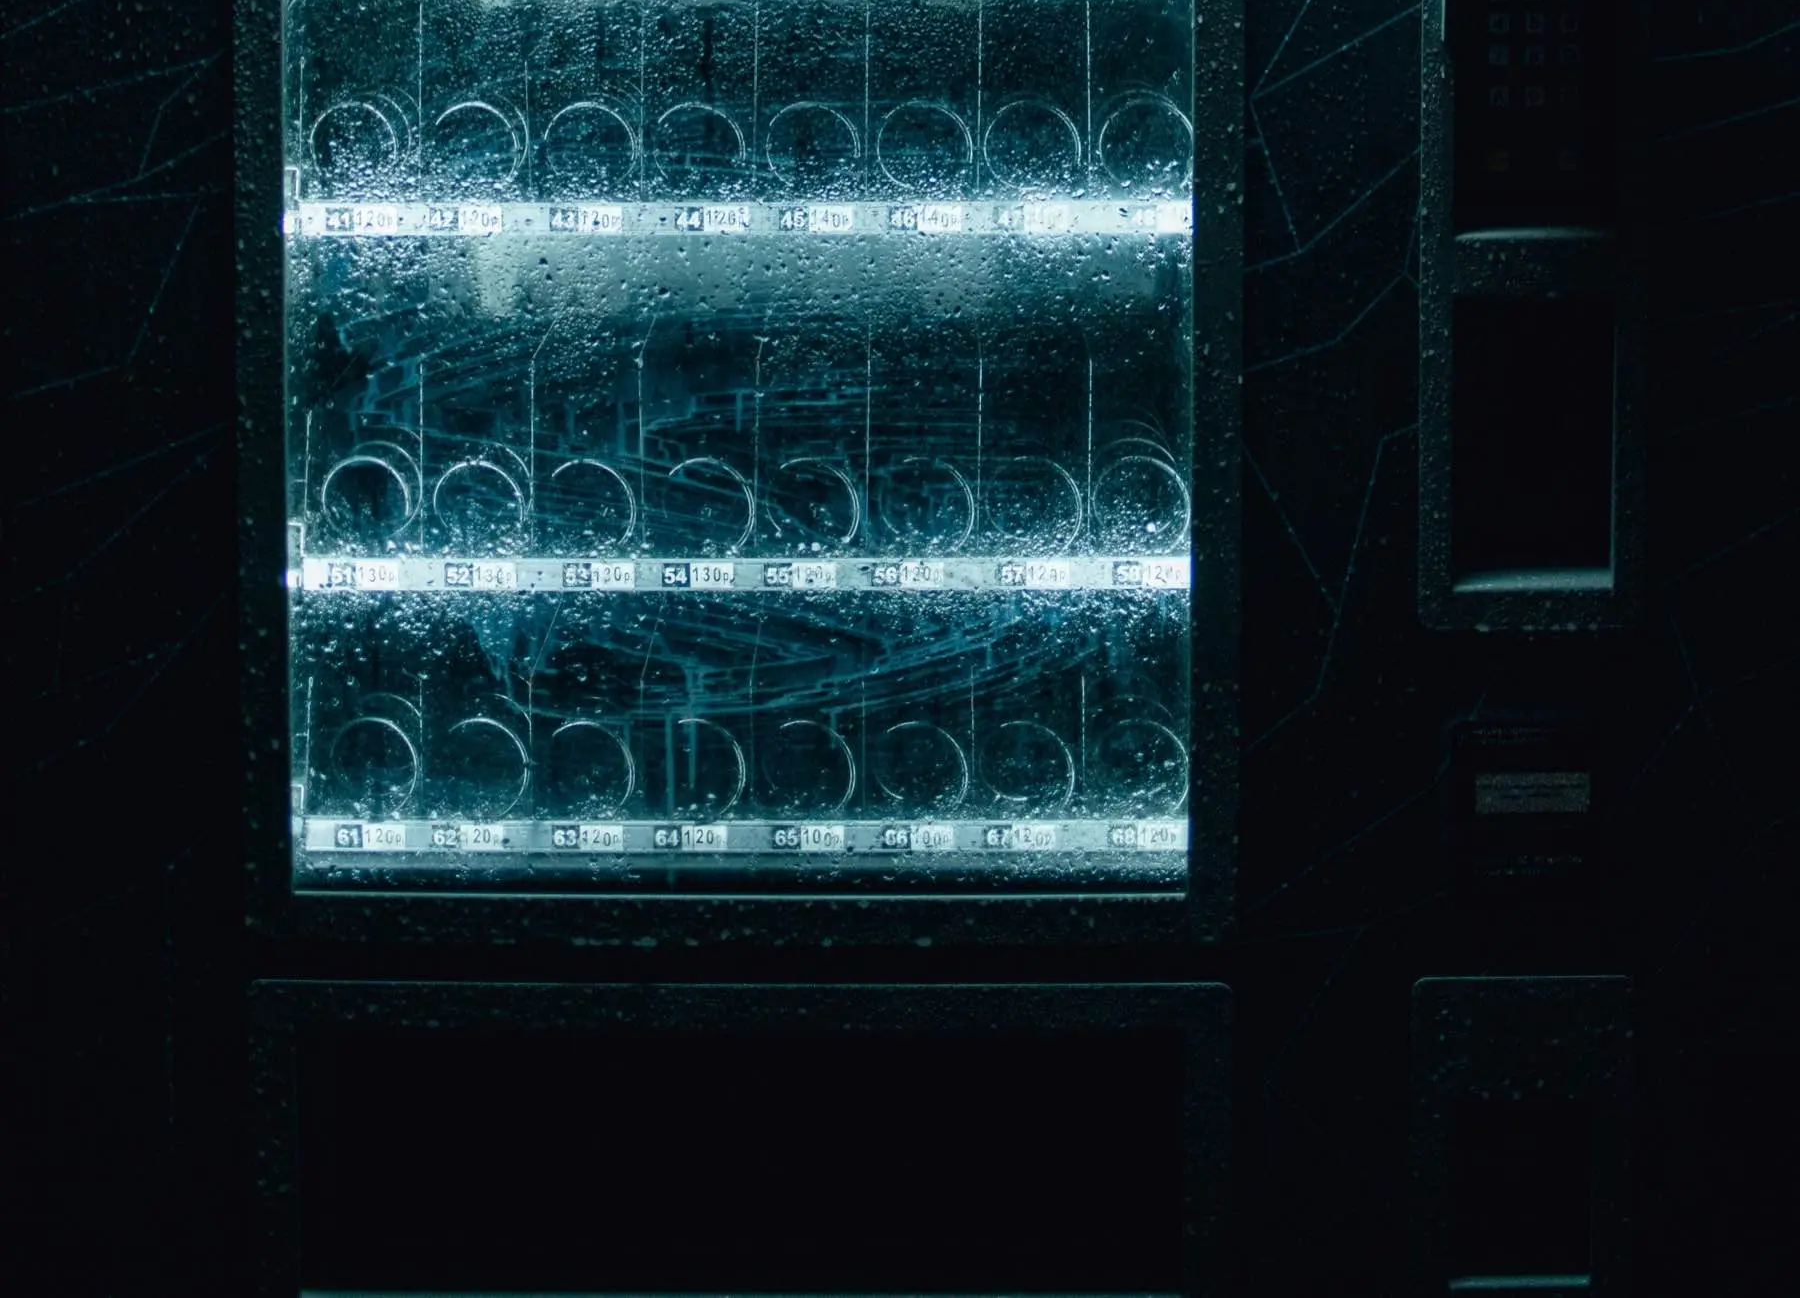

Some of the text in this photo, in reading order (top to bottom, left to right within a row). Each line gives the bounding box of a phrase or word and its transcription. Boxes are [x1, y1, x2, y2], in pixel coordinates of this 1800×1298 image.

[328, 210, 353, 229] 41
[431, 210, 454, 227] 42
[551, 209, 577, 229] 43
[677, 210, 702, 229] 44
[781, 209, 807, 229] 45
[331, 567, 353, 585] 51
[446, 566, 470, 585] 52
[566, 566, 591, 586] 53
[664, 566, 688, 585] 54
[766, 567, 790, 585] 55
[874, 566, 900, 585] 56
[1001, 566, 1024, 583] 57
[338, 828, 361, 846] 61
[434, 829, 457, 846] 62
[553, 828, 579, 847] 63
[655, 828, 679, 846] 64
[775, 829, 798, 847] 65
[884, 829, 908, 846] 66
[987, 828, 1010, 846] 67
[1112, 828, 1137, 846] 68
